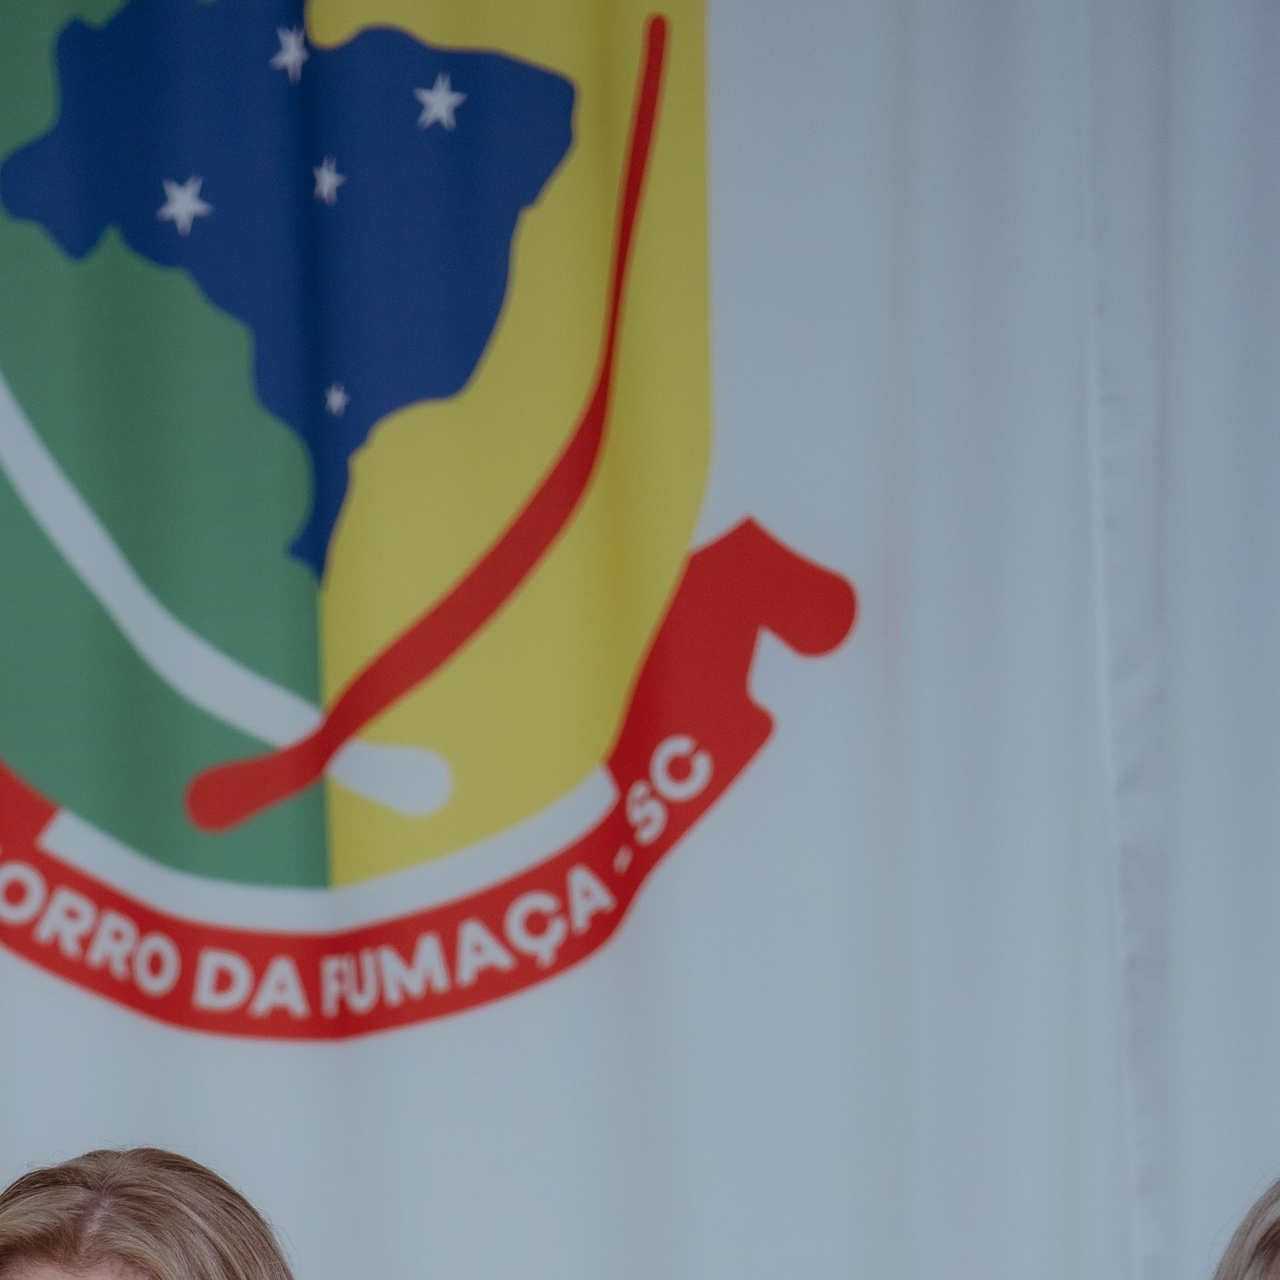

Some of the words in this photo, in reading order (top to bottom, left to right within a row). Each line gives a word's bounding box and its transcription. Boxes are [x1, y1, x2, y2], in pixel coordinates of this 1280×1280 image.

[192, 946, 312, 1019] DA
[322, 863, 617, 1018] FUMAÇA
[626, 734, 714, 845] SC
